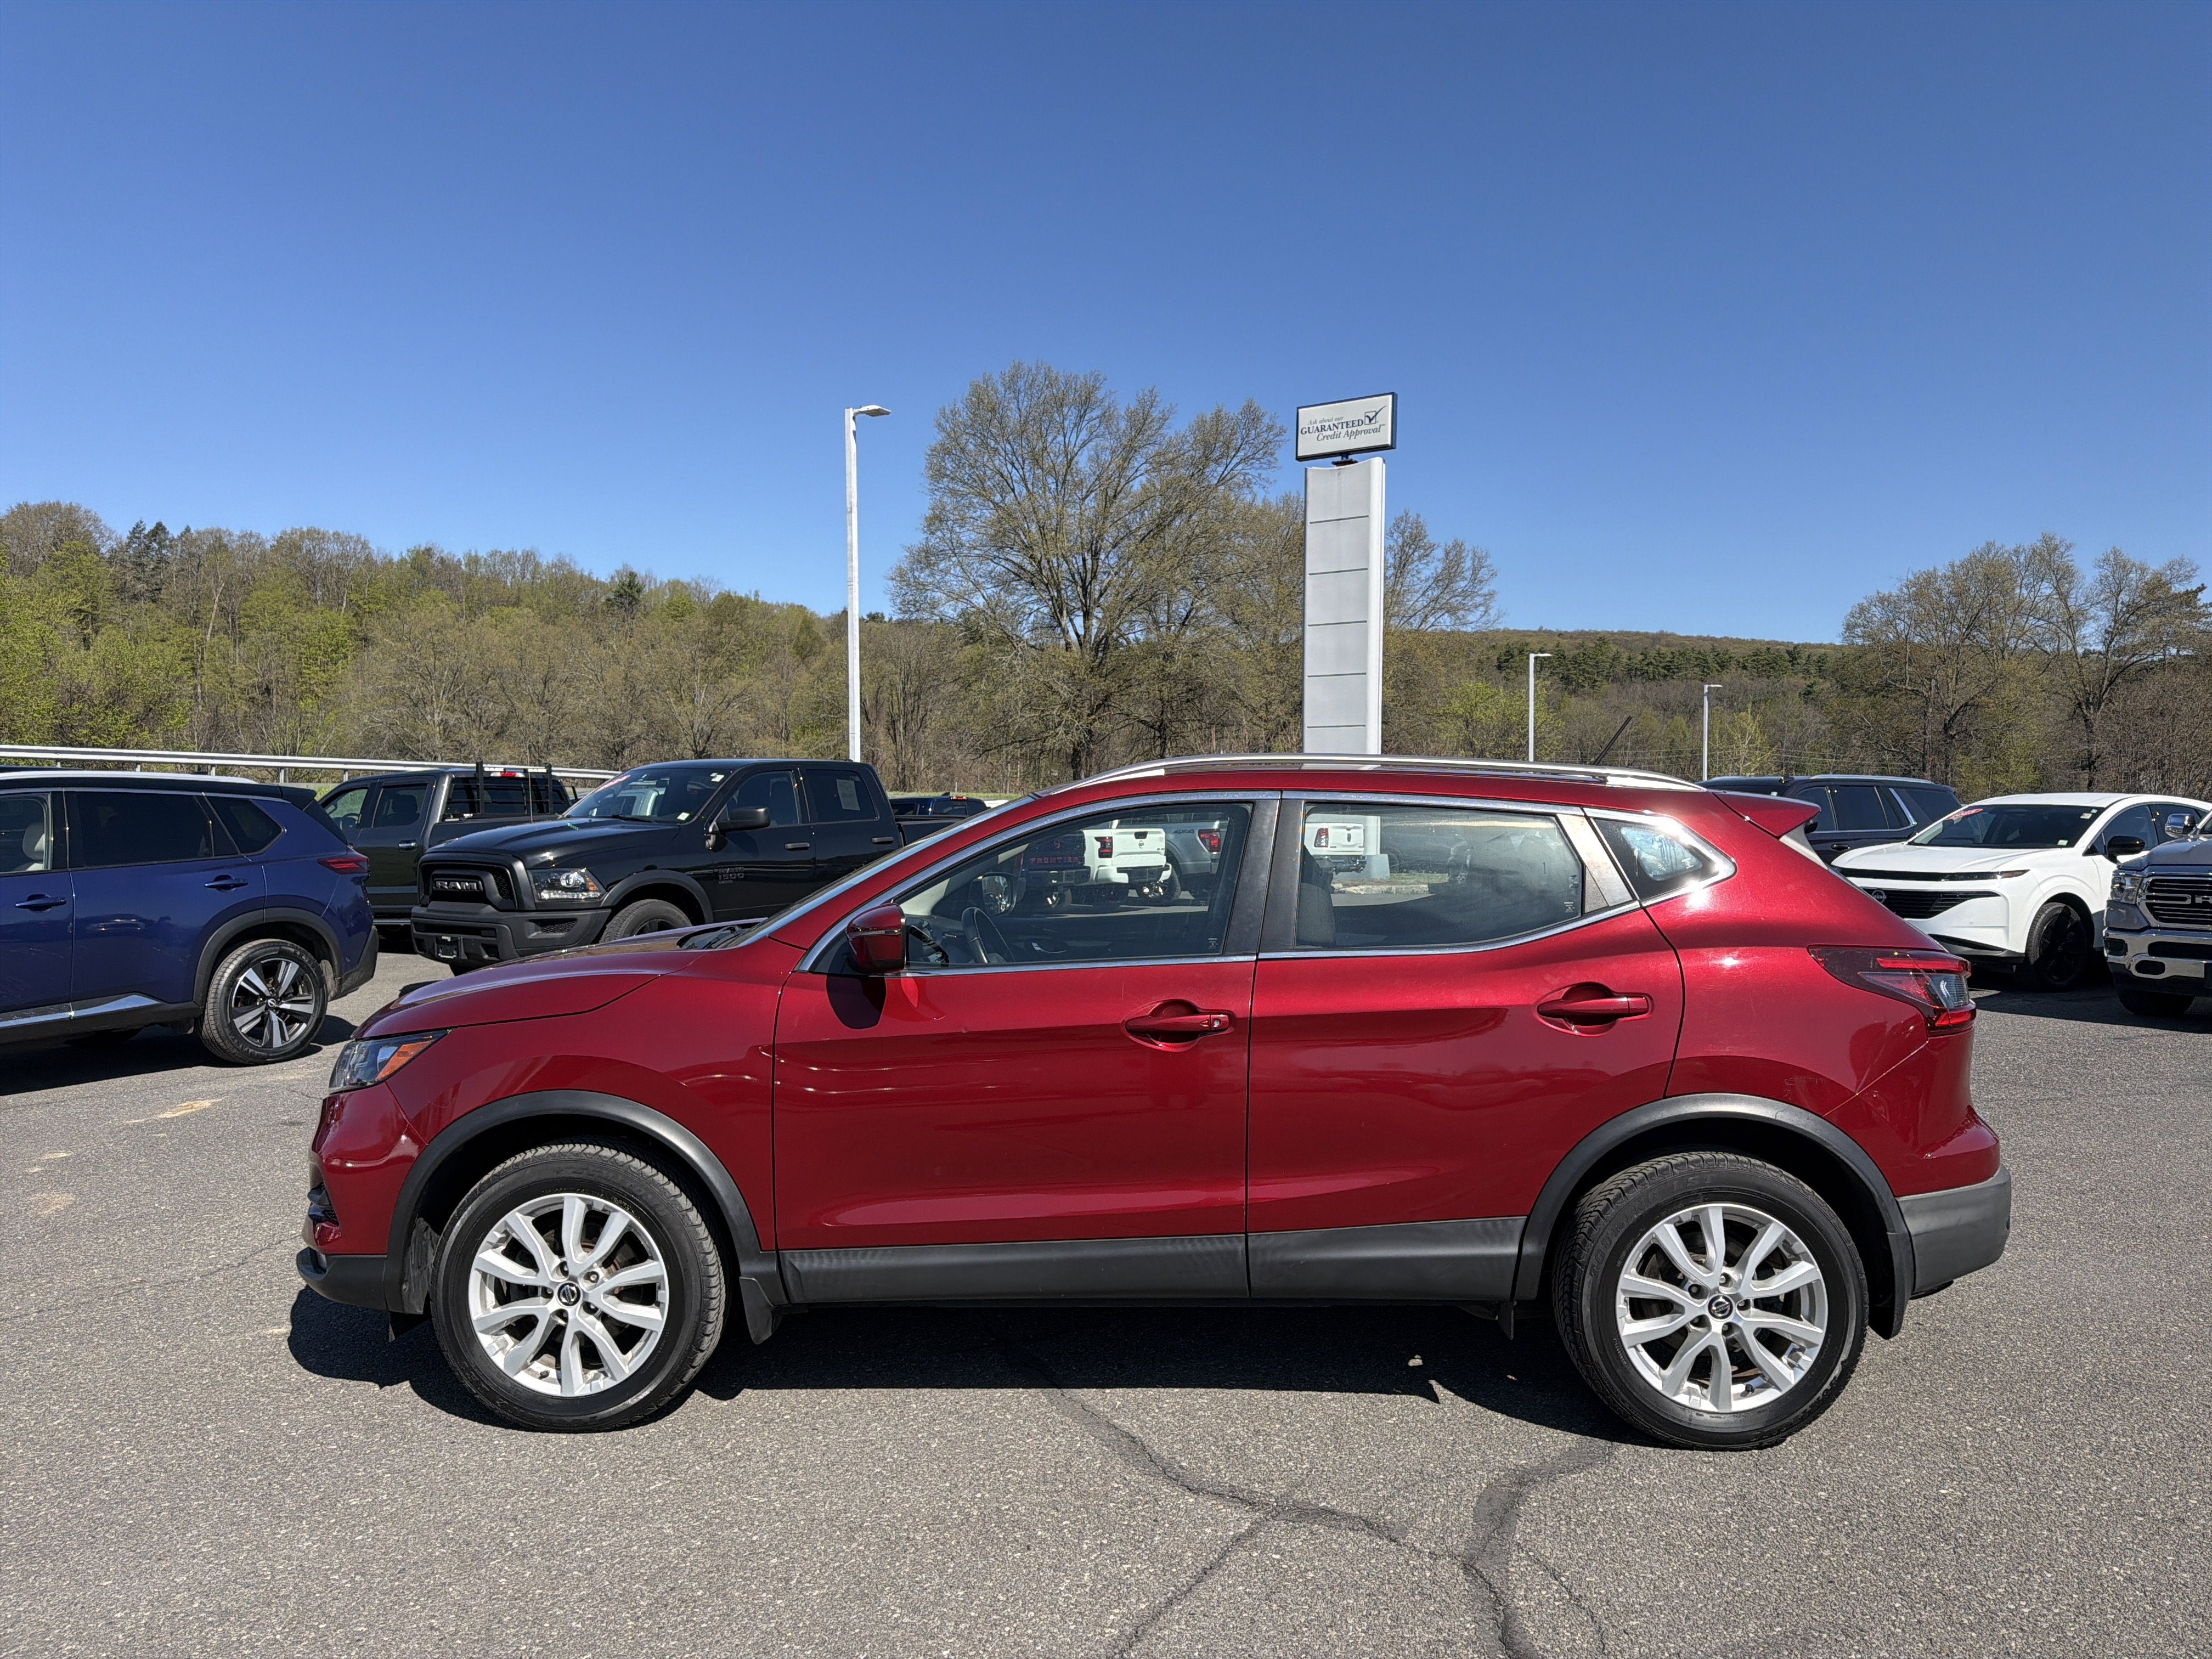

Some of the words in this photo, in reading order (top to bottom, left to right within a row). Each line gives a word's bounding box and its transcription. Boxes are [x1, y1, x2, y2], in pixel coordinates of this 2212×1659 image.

[1300, 419, 1364, 435] GUARANTEED
[1317, 430, 1341, 442] Credit
[1342, 425, 1382, 440] Approval
[436, 881, 477, 890] RAM
